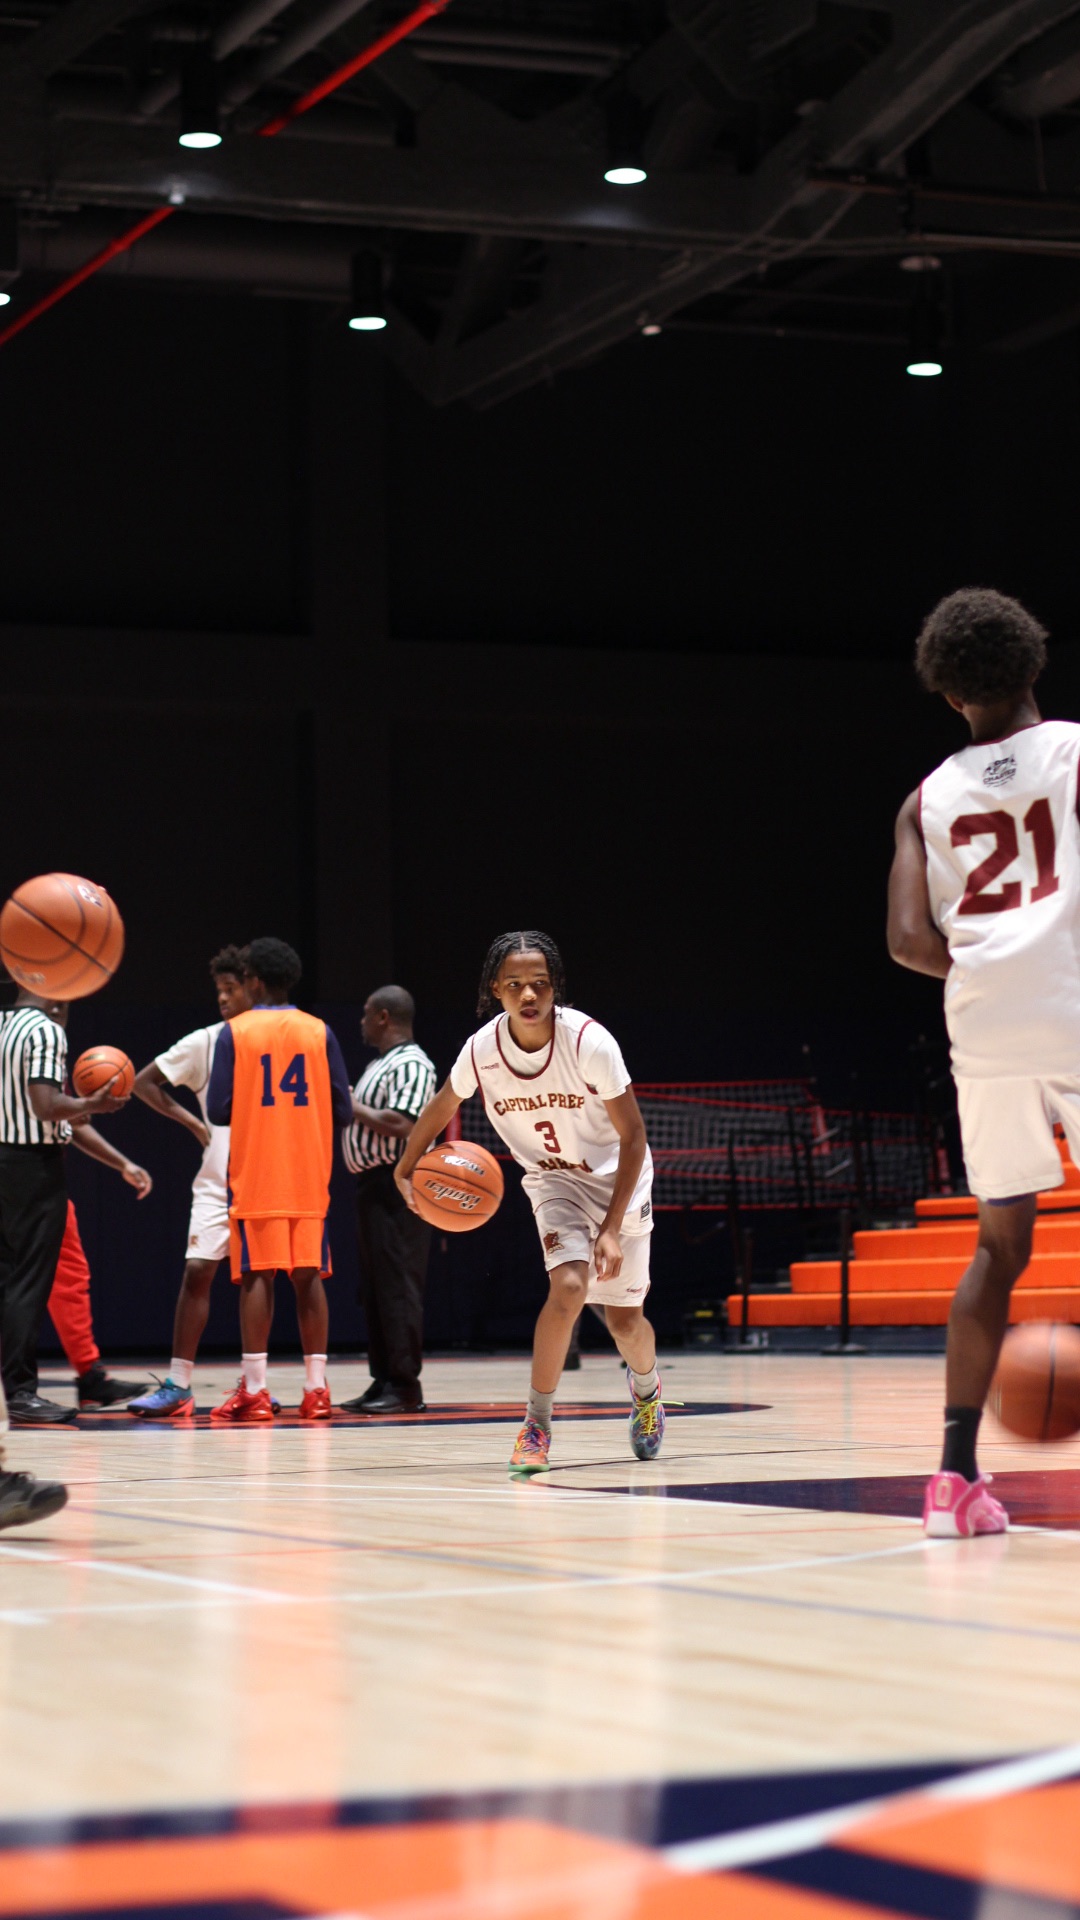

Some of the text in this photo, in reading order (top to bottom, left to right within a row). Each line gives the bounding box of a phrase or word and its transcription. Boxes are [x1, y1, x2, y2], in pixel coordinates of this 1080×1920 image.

[949, 797, 1060, 916] 21
[260, 1052, 309, 1107] 14
[493, 1092, 585, 1116] CAPITAL PREP
[534, 1119, 562, 1154] 3
[424, 1178, 484, 1211] Baden
